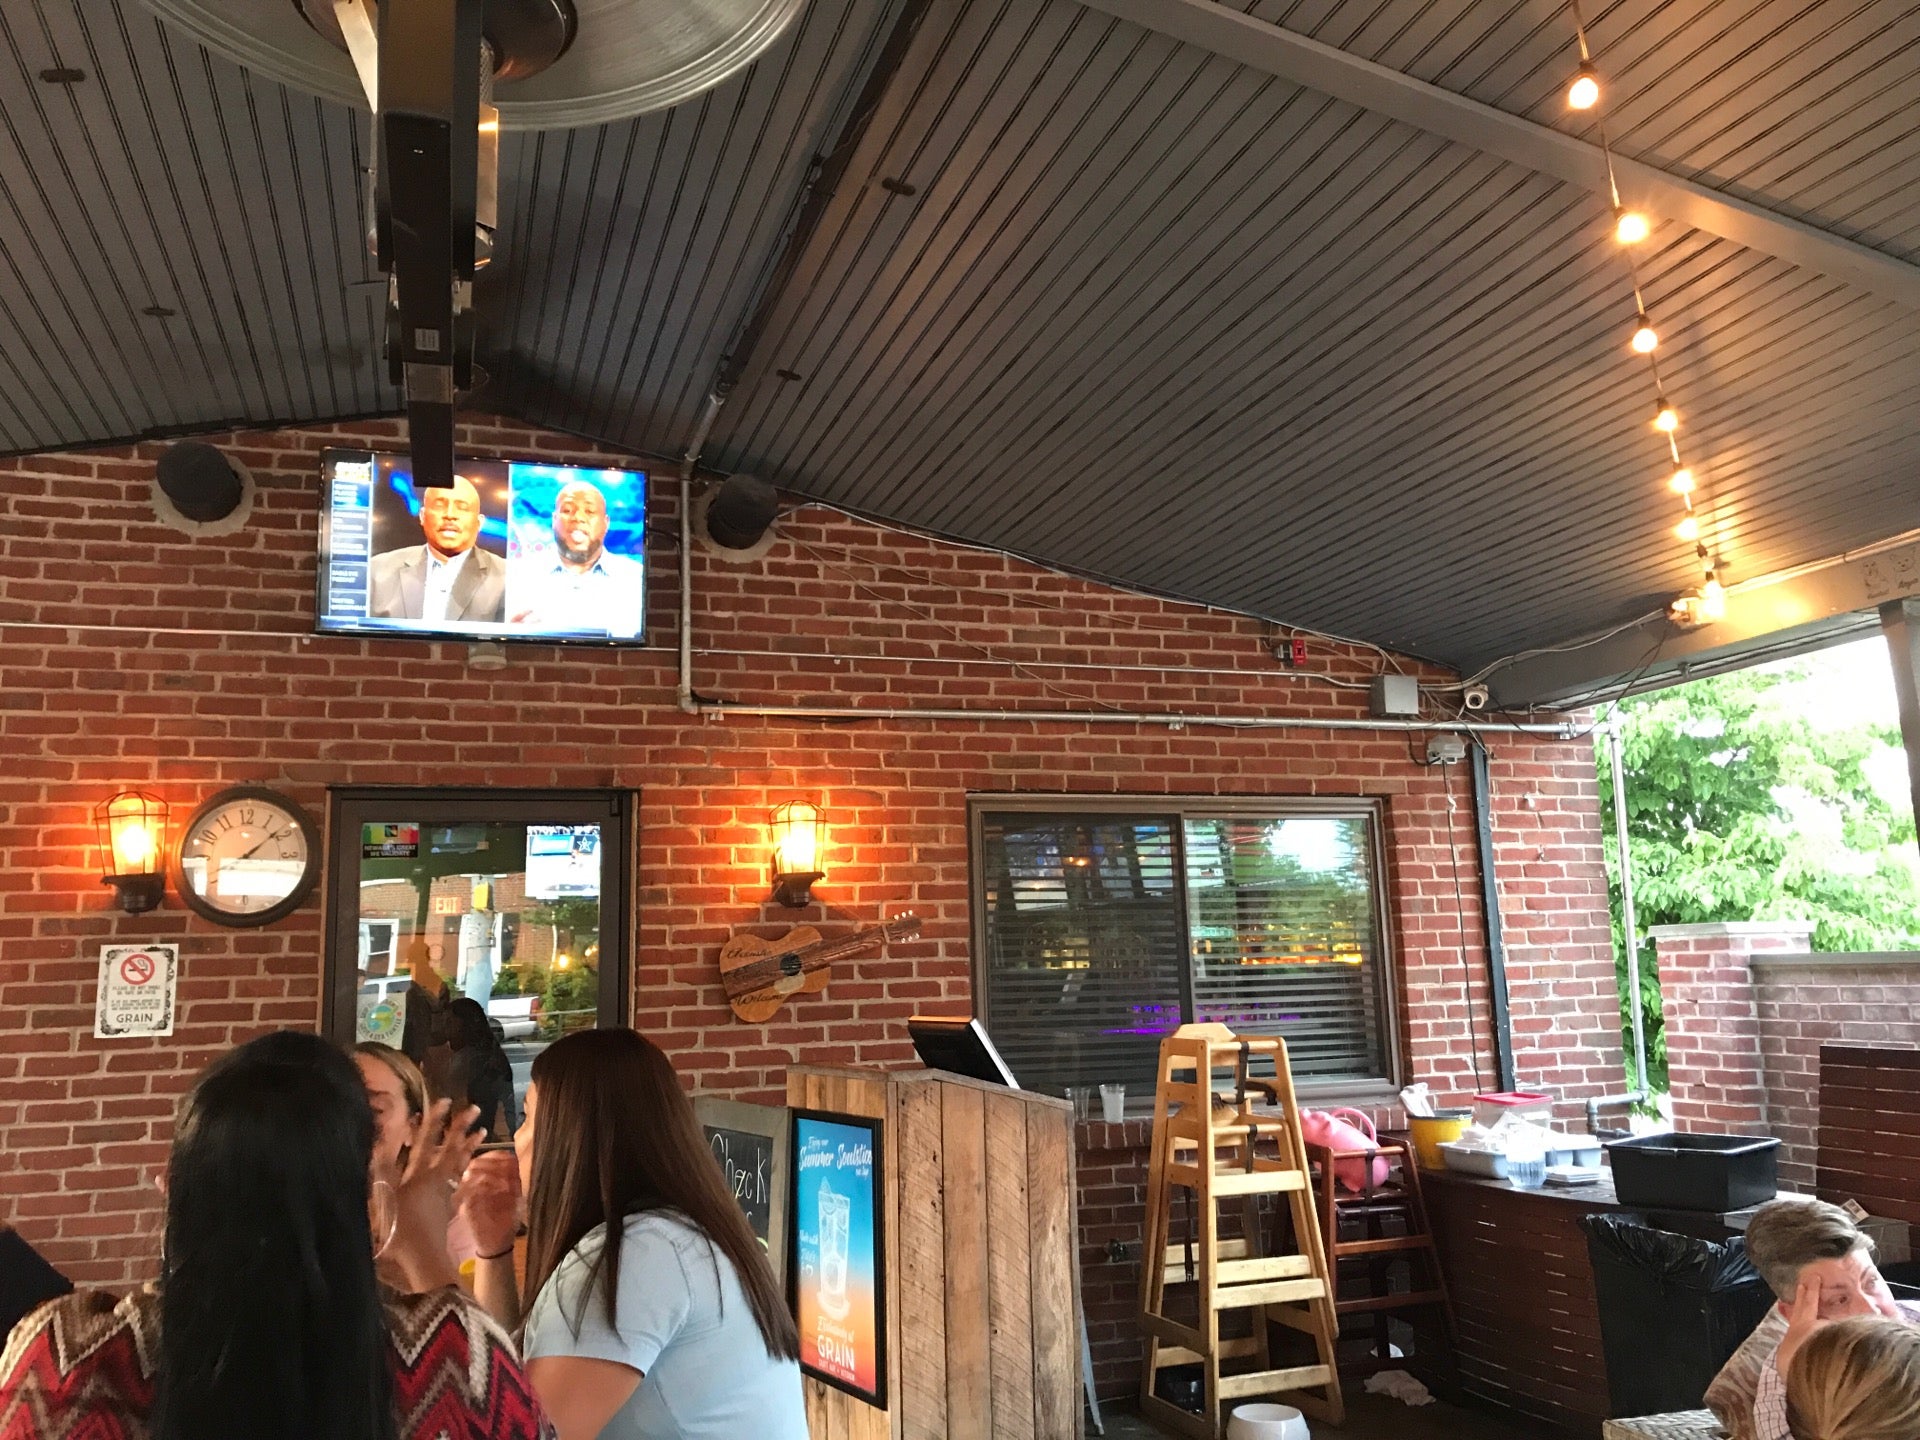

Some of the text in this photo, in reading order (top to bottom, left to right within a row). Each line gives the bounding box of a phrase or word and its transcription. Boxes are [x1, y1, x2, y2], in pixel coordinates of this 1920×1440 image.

[240, 809, 254, 825] 12
[437, 897, 458, 914] EXIT
[116, 1013, 153, 1024] GRAIN
[799, 1146, 835, 1172] Summer
[817, 1334, 855, 1372] GRAIN
